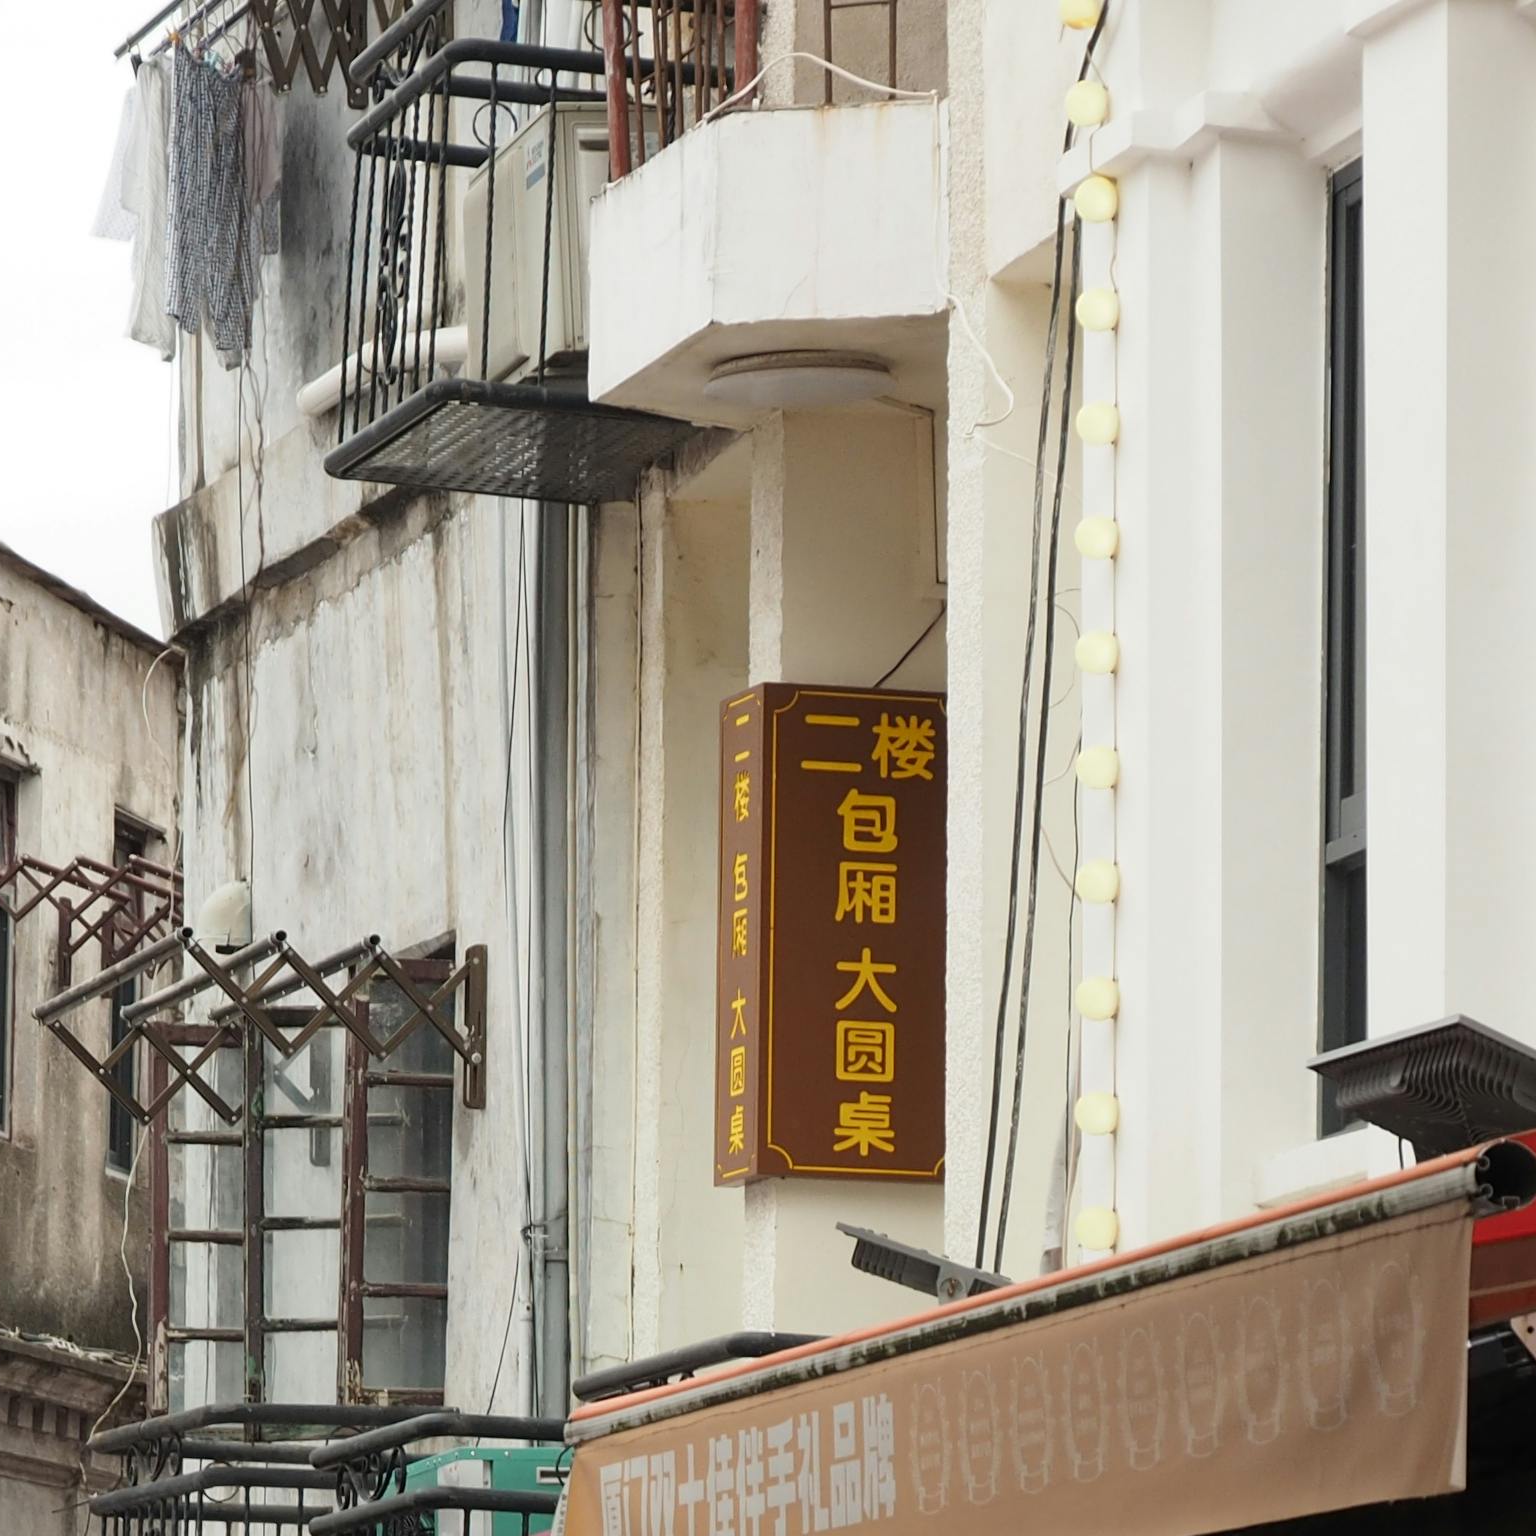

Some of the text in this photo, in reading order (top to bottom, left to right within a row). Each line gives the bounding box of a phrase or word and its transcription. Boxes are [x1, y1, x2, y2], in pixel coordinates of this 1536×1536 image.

[801, 713, 937, 781] 二楼
[832, 787, 899, 1156] 包厢 大圆桌
[728, 995, 748, 1154] 大圆桌
